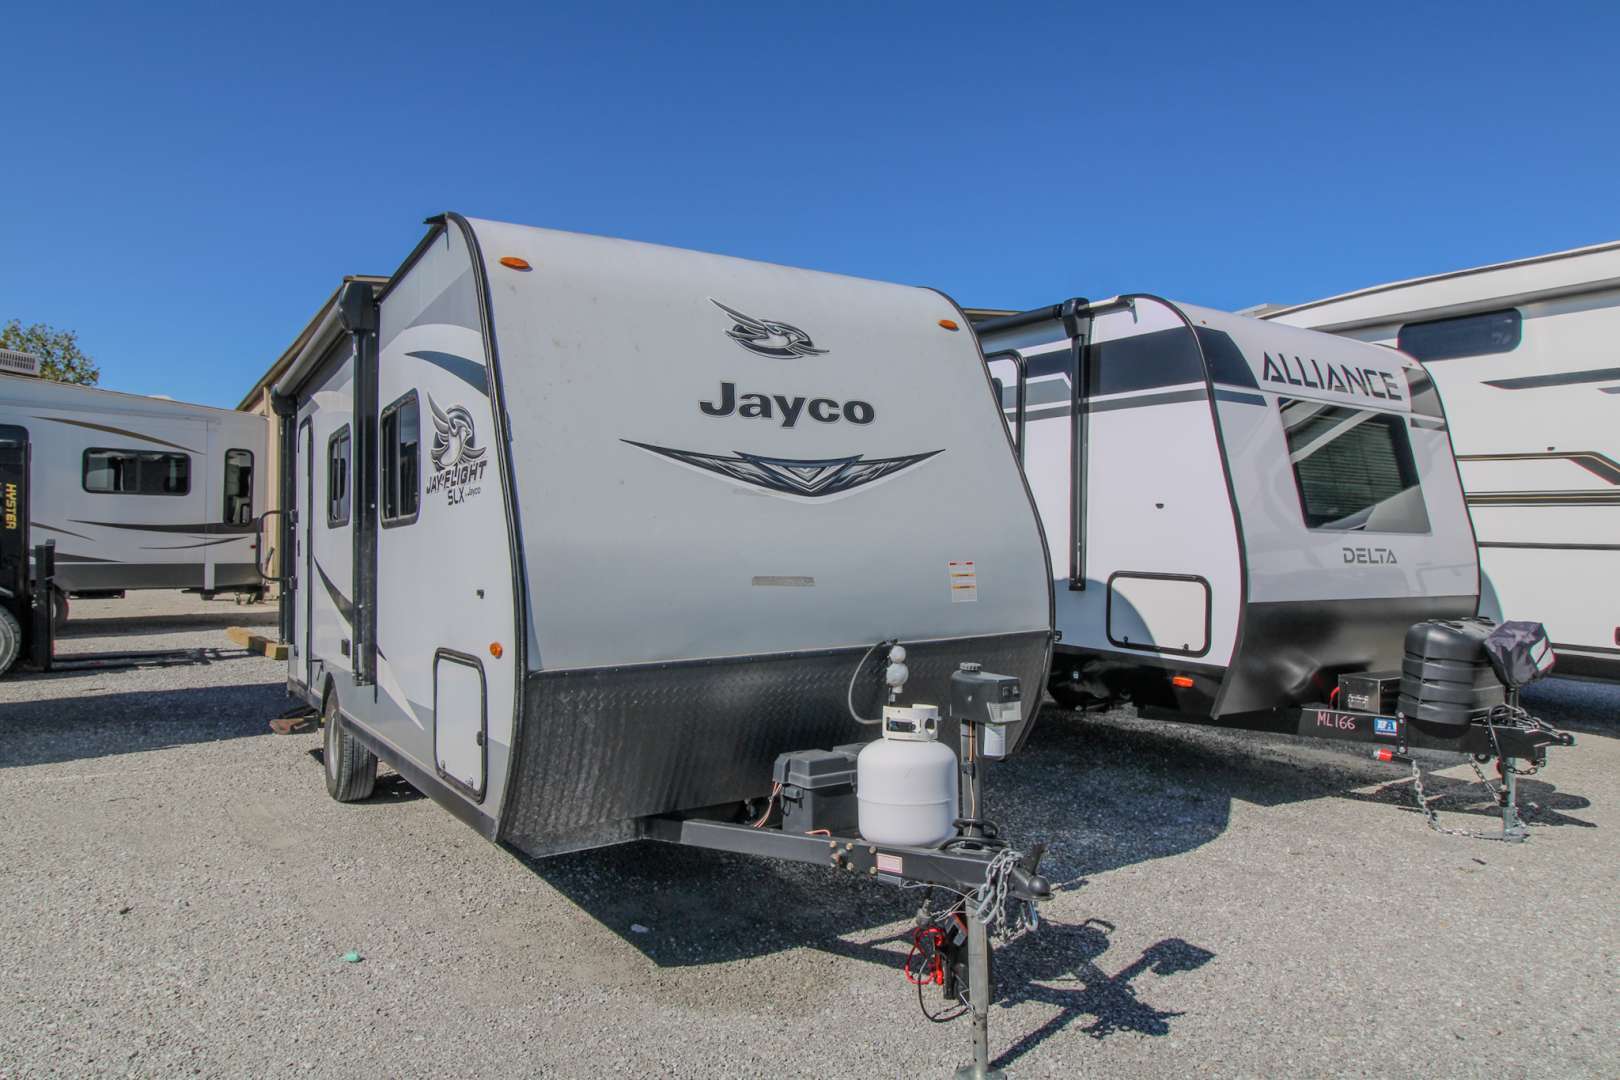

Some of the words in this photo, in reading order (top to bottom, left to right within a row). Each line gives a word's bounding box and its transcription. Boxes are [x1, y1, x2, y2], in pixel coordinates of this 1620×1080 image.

[1263, 351, 1402, 401] ALLIANCE
[699, 381, 875, 427] Jayco
[426, 473, 443, 494] JAY
[443, 460, 488, 489] FLIGHT
[5, 483, 17, 530] HYSTER
[447, 487, 465, 506] SLX
[1342, 548, 1398, 564] DELTA
[1317, 710, 1356, 730] ML166
